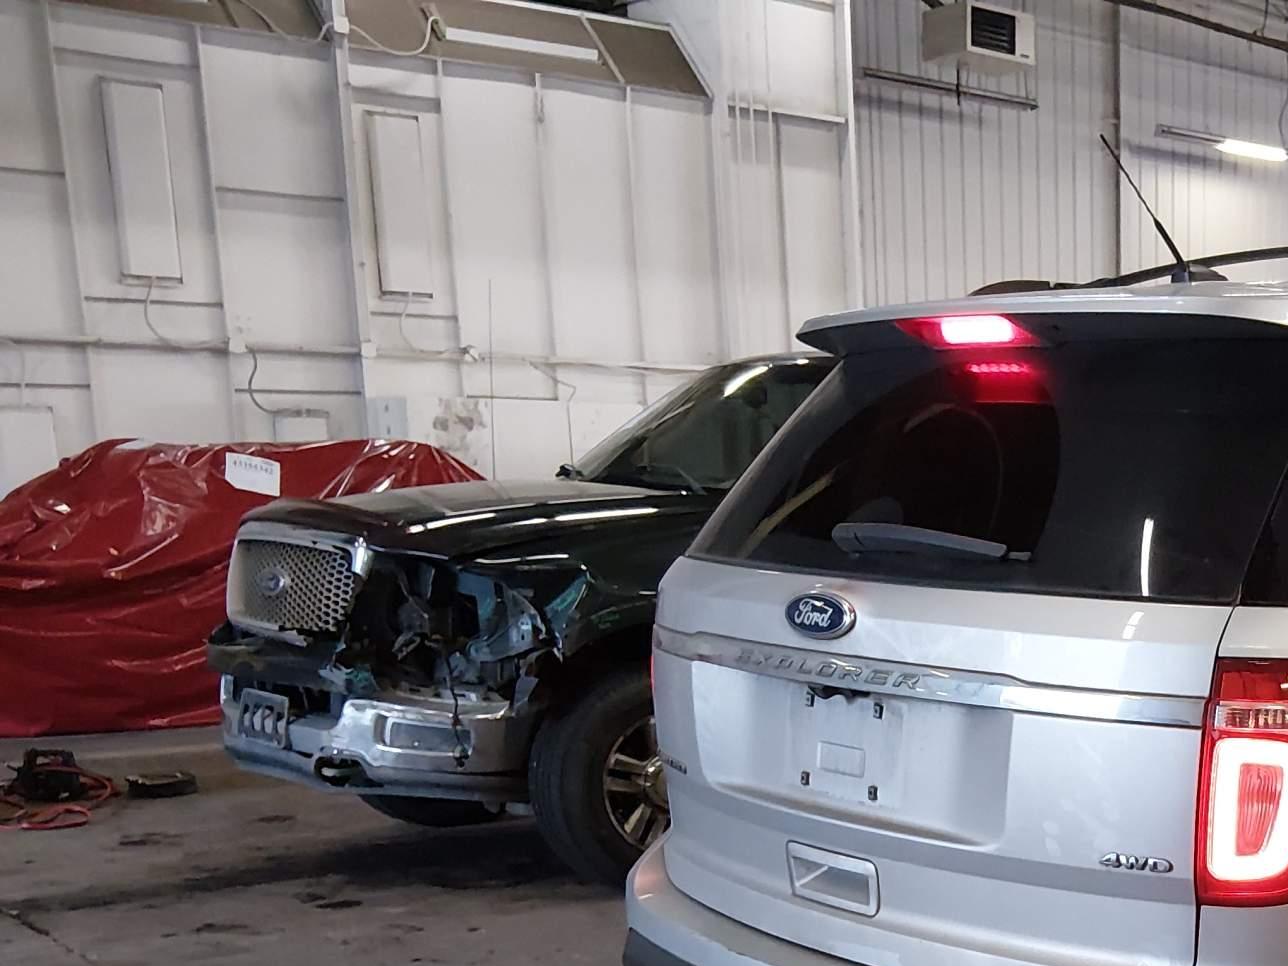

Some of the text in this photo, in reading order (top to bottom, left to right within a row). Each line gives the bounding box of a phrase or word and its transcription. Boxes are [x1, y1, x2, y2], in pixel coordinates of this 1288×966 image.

[794, 598, 833, 628] Ford
[735, 647, 921, 690] EXPLORER
[1099, 851, 1174, 873] 4WD
